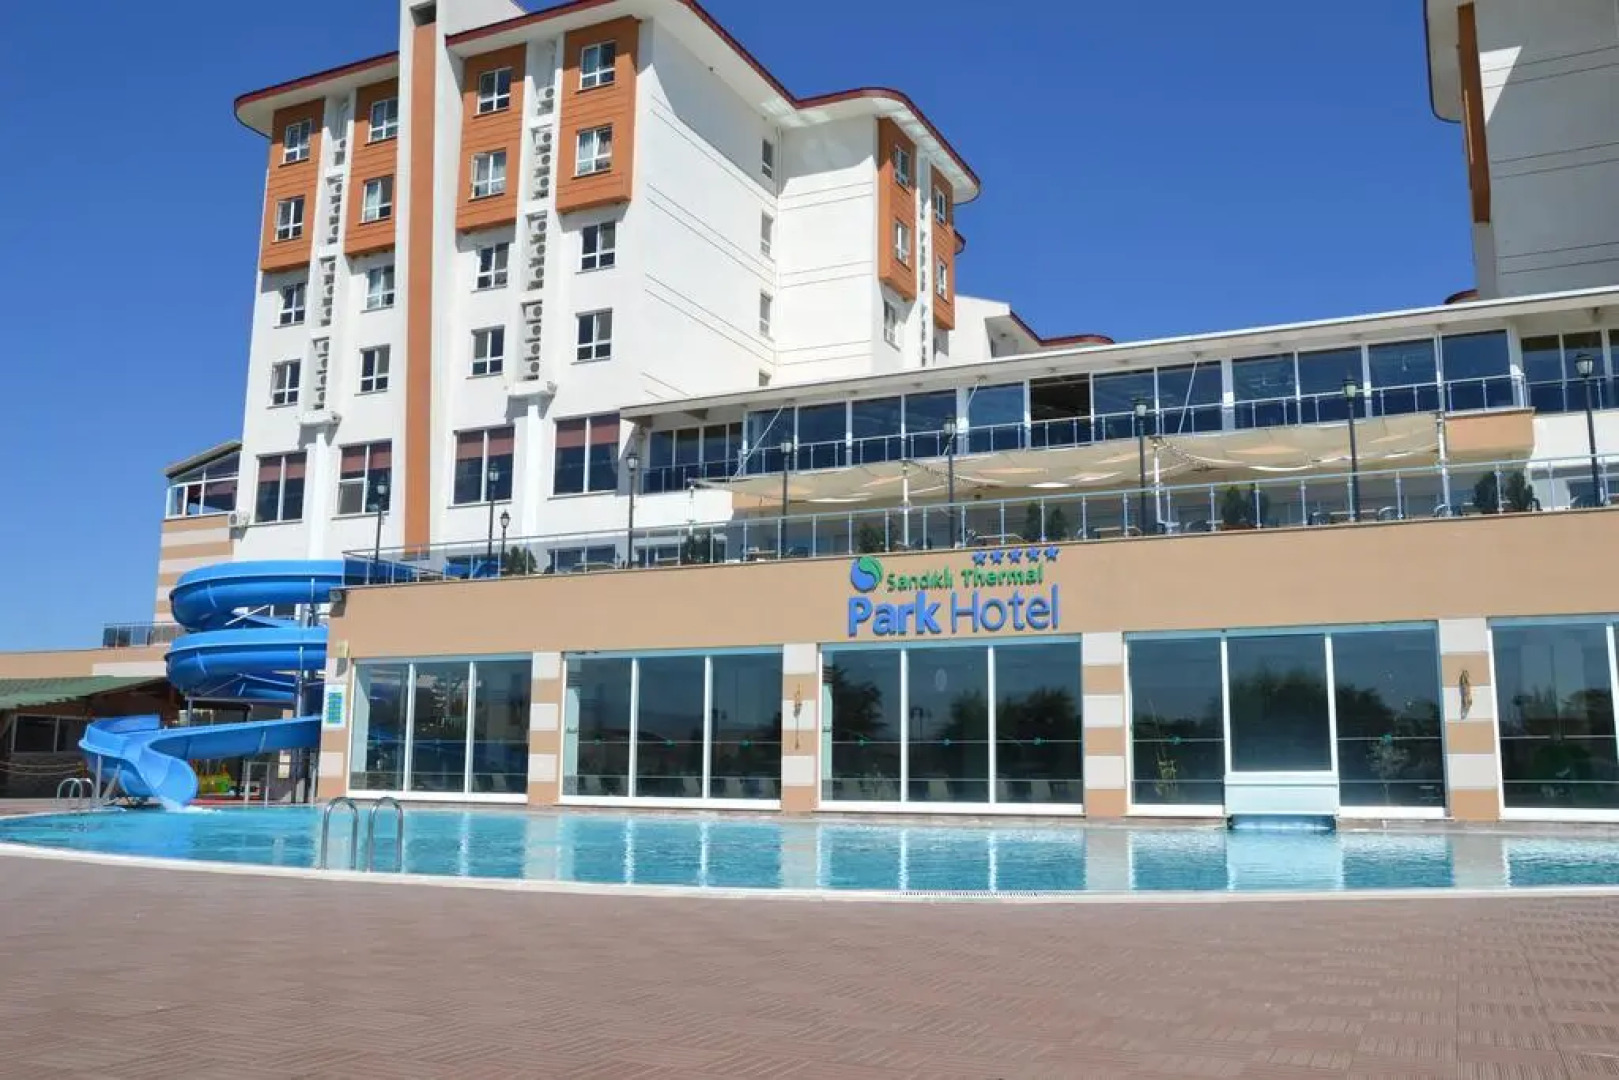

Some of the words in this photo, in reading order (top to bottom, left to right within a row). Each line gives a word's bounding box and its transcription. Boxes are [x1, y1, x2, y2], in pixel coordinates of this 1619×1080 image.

[961, 563, 1043, 587] Thermal
[848, 591, 942, 637] Park
[951, 584, 1059, 634] Hotel
